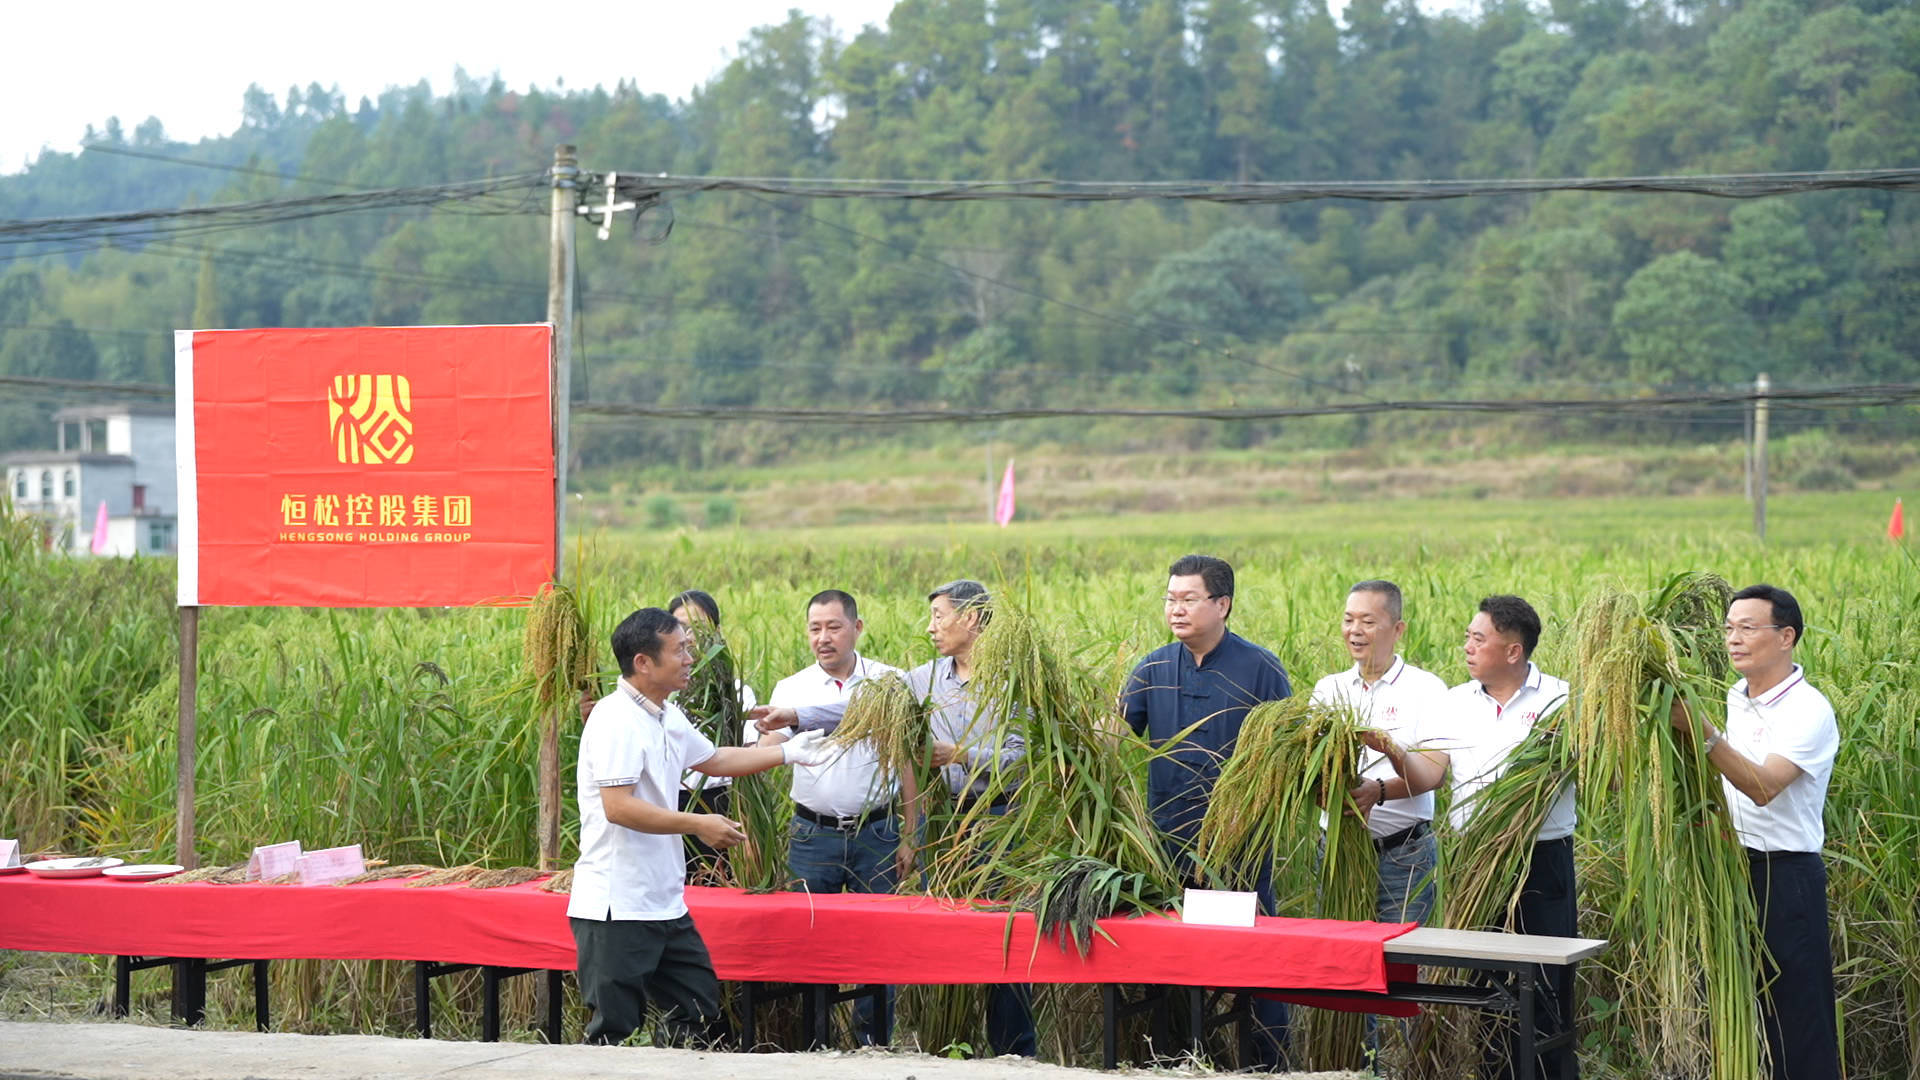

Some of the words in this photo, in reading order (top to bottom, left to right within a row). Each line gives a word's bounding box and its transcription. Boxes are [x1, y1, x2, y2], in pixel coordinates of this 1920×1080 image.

[280, 493, 472, 527] 恒松控股集团
[279, 532, 353, 543] HENGSONG
[359, 532, 419, 543] HOLDING
[424, 532, 472, 543] GROUP
